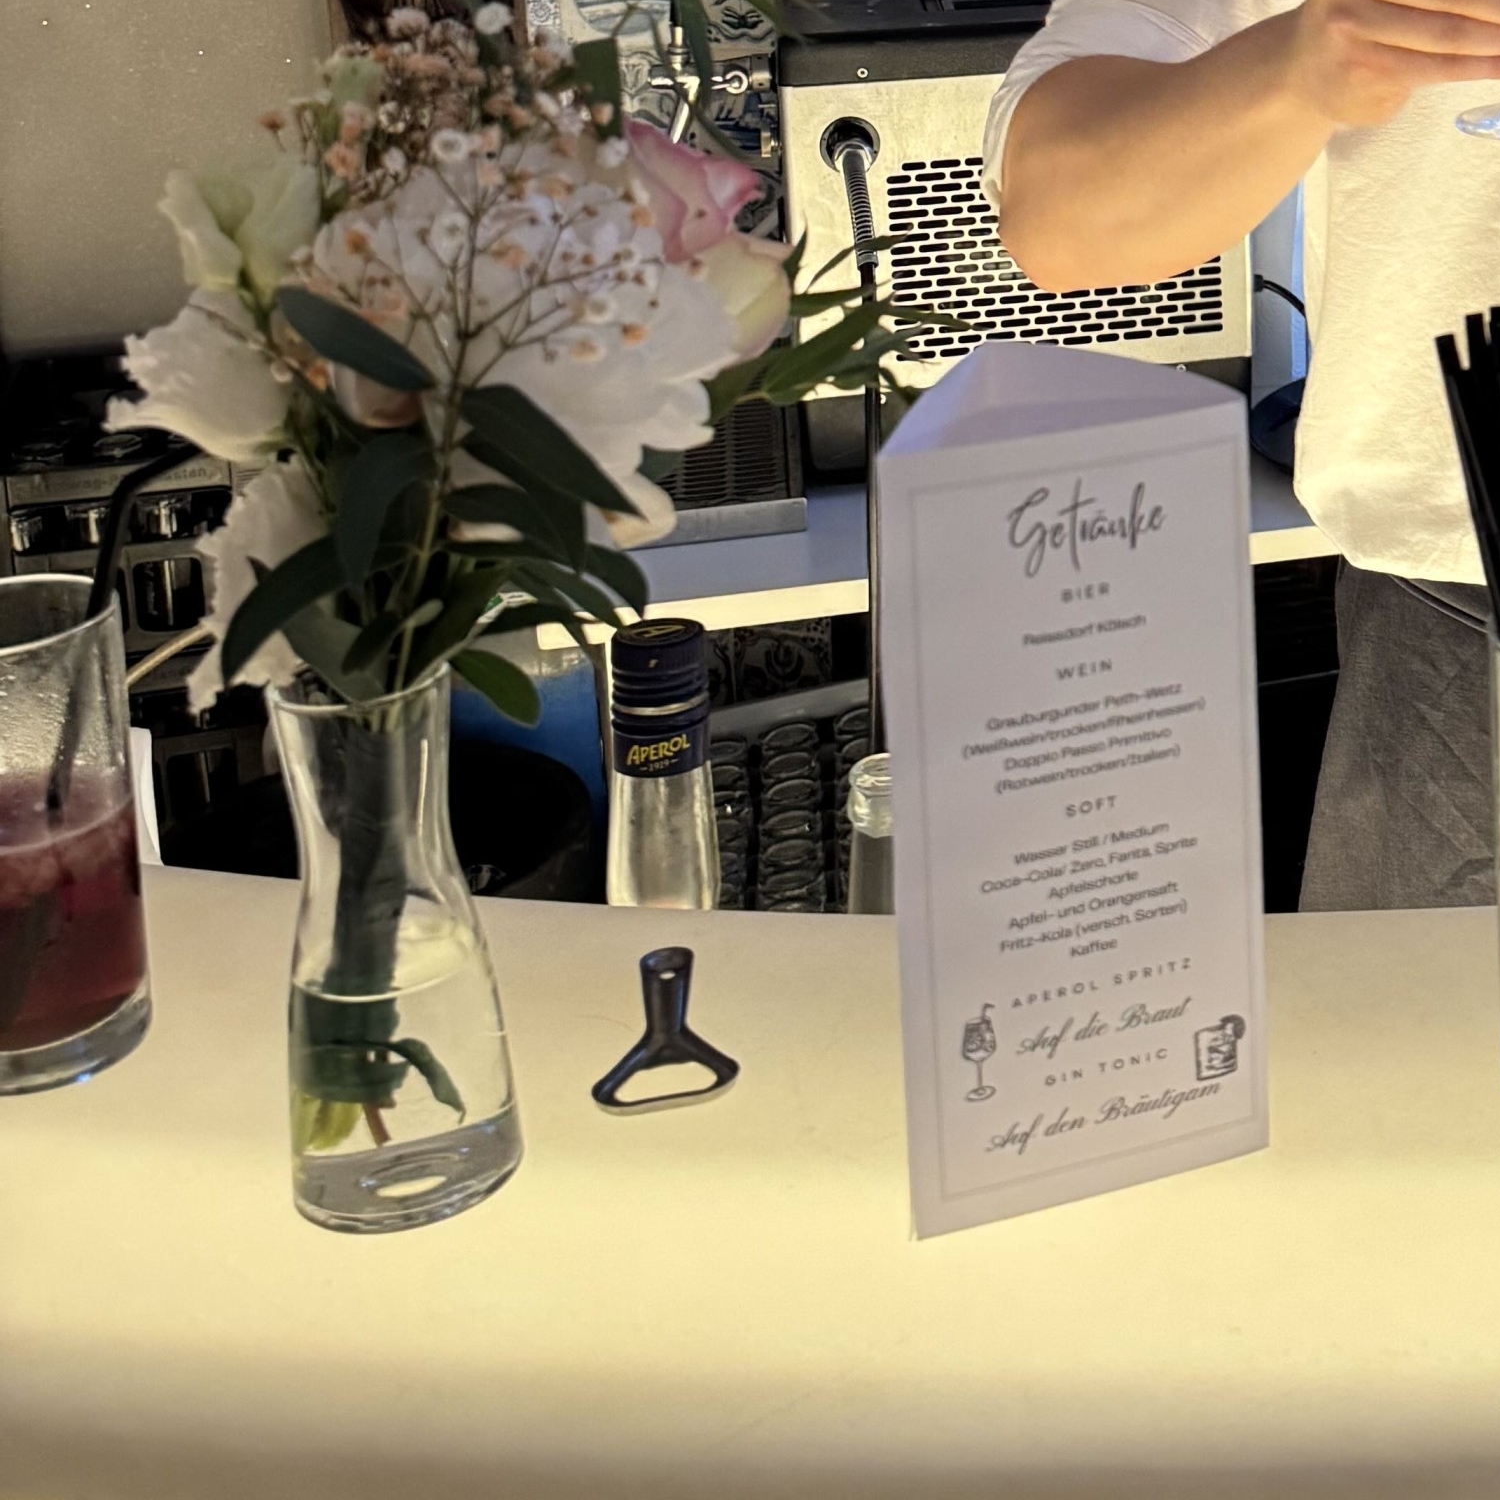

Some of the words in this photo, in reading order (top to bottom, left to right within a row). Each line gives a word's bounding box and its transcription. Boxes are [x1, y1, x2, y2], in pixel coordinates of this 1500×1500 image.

[1006, 477, 1166, 578] Getränke
[1060, 581, 1110, 604] BIER
[1056, 658, 1113, 681] WEIN
[985, 700, 1100, 731] Grauburgunder
[626, 733, 692, 766] APEROL
[1003, 748, 1060, 771] Doppio
[1065, 795, 1118, 818] SOFT
[1014, 845, 1067, 865] Wasser
[1071, 836, 1099, 853] Still
[1111, 822, 1170, 843] Medium
[1155, 836, 1198, 856] Sprite
[1048, 869, 1139, 899] Apfelschorle
[1008, 909, 1054, 931] Apfel-
[1057, 902, 1086, 919] und
[1088, 881, 1179, 912] Orangensaft
[999, 927, 1072, 953] Fritz-Kola
[1134, 898, 1188, 922] Sorten)
[1069, 938, 1118, 958] Kaffee
[1011, 980, 1099, 1008] APEROL
[1112, 957, 1191, 986] SPRITZ
[1015, 1016, 1074, 1060] Auf
[1073, 1011, 1109, 1042] die
[1115, 995, 1192, 1032] Braut
[1044, 1069, 1084, 1086] GIN
[1098, 1047, 1169, 1073] TONIC
[984, 1113, 1045, 1155] Auf
[1043, 1107, 1087, 1138] den
[1094, 1082, 1220, 1124] Bräutigam
